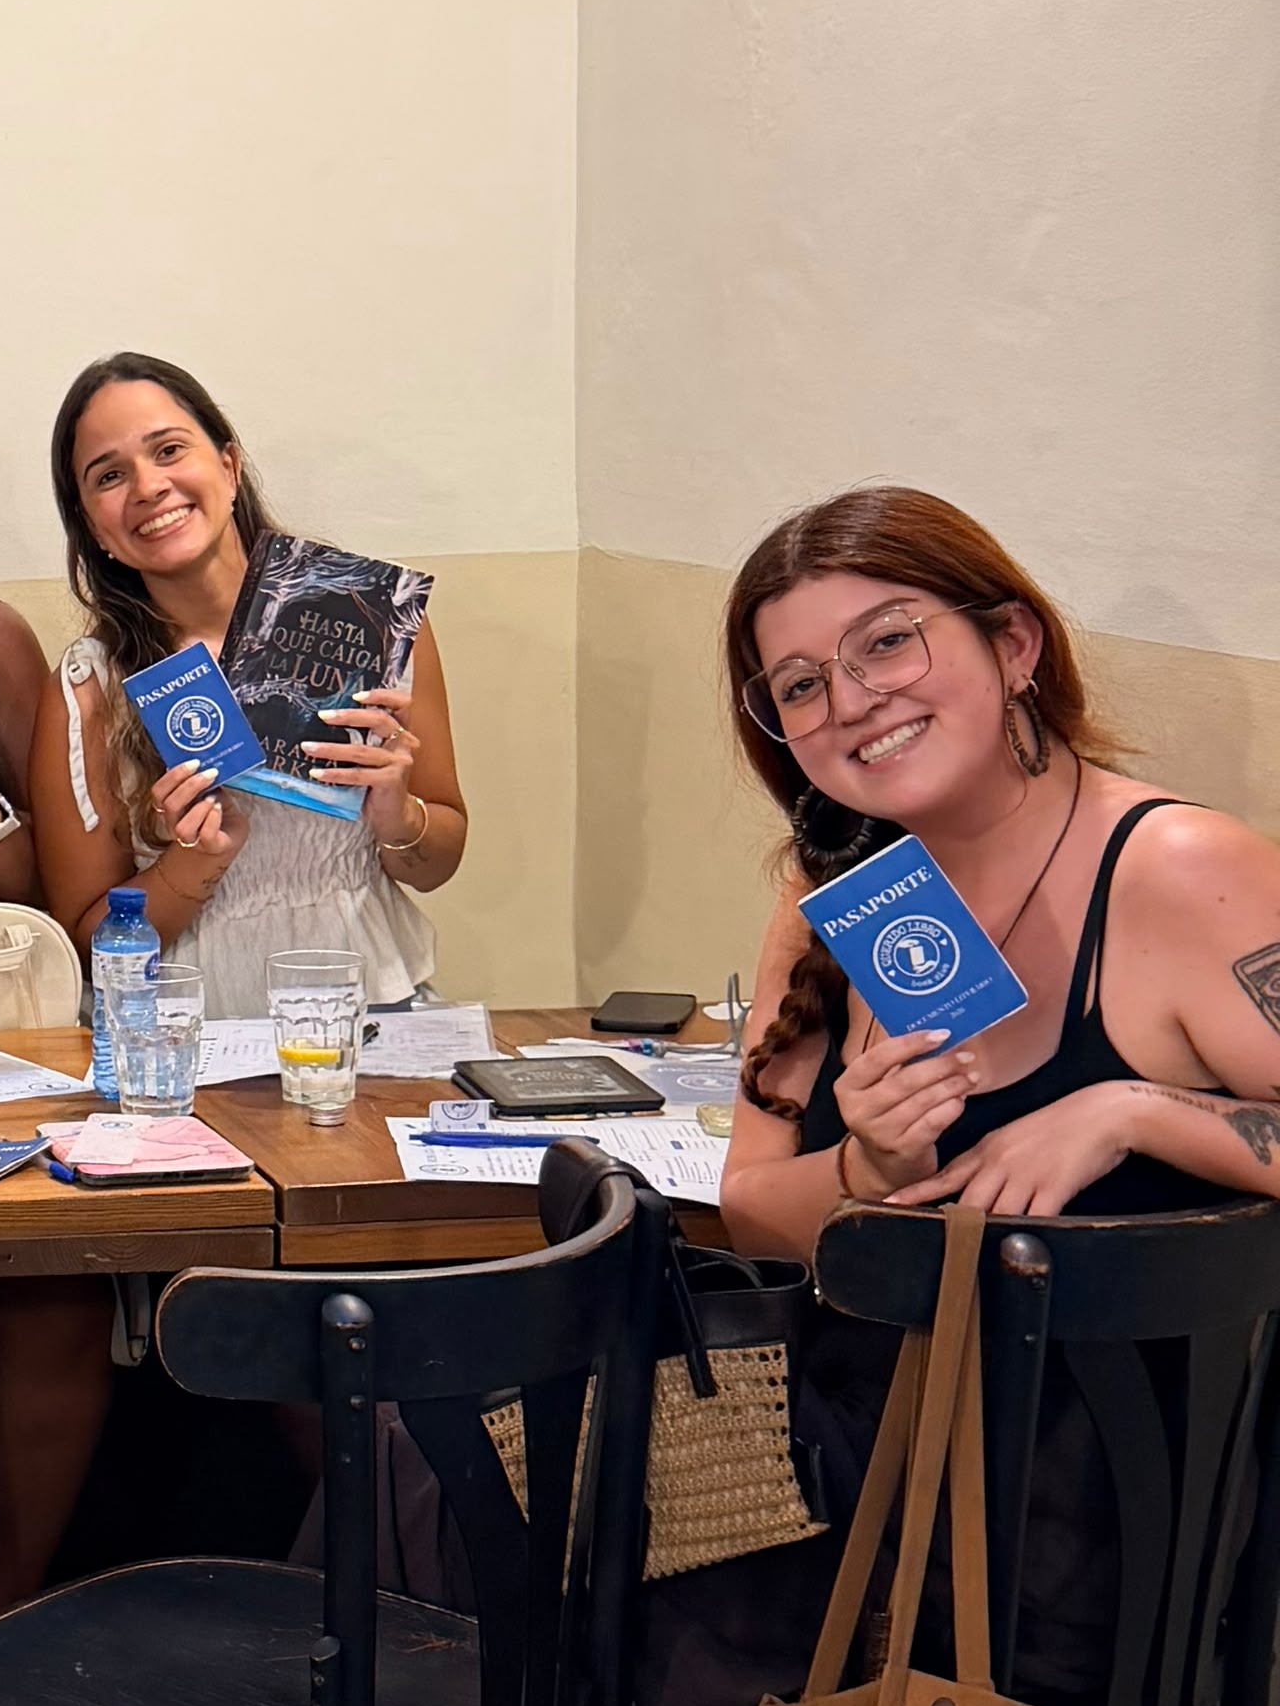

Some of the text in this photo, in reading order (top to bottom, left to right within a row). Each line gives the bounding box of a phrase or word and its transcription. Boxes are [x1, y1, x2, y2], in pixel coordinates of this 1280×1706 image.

[272, 626, 316, 653] QUE
[319, 639, 383, 674] CAIGA
[299, 609, 366, 646] HASTA
[135, 662, 212, 709] PASAPORTE
[268, 653, 288, 671] LA
[290, 653, 366, 695] LUNA
[822, 865, 933, 938] PASAPORTE
